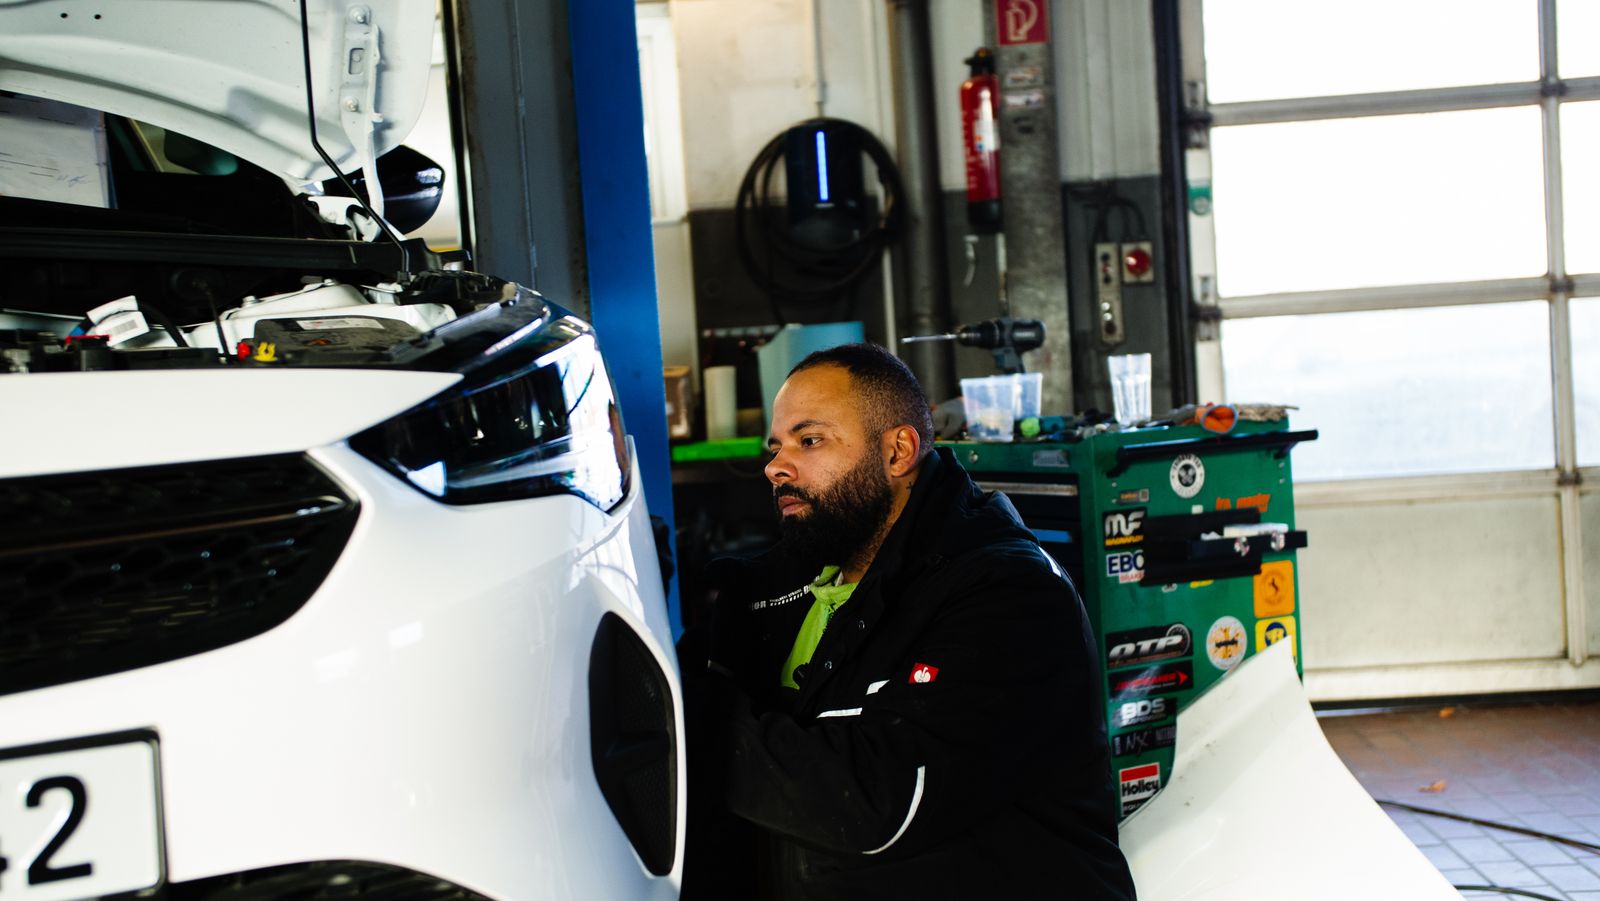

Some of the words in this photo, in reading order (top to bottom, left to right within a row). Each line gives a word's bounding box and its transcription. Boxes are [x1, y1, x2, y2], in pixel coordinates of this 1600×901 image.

[1120, 697, 1167, 720] BDS
[1122, 779, 1159, 797] Holley
[0, 775, 92, 886] 2
